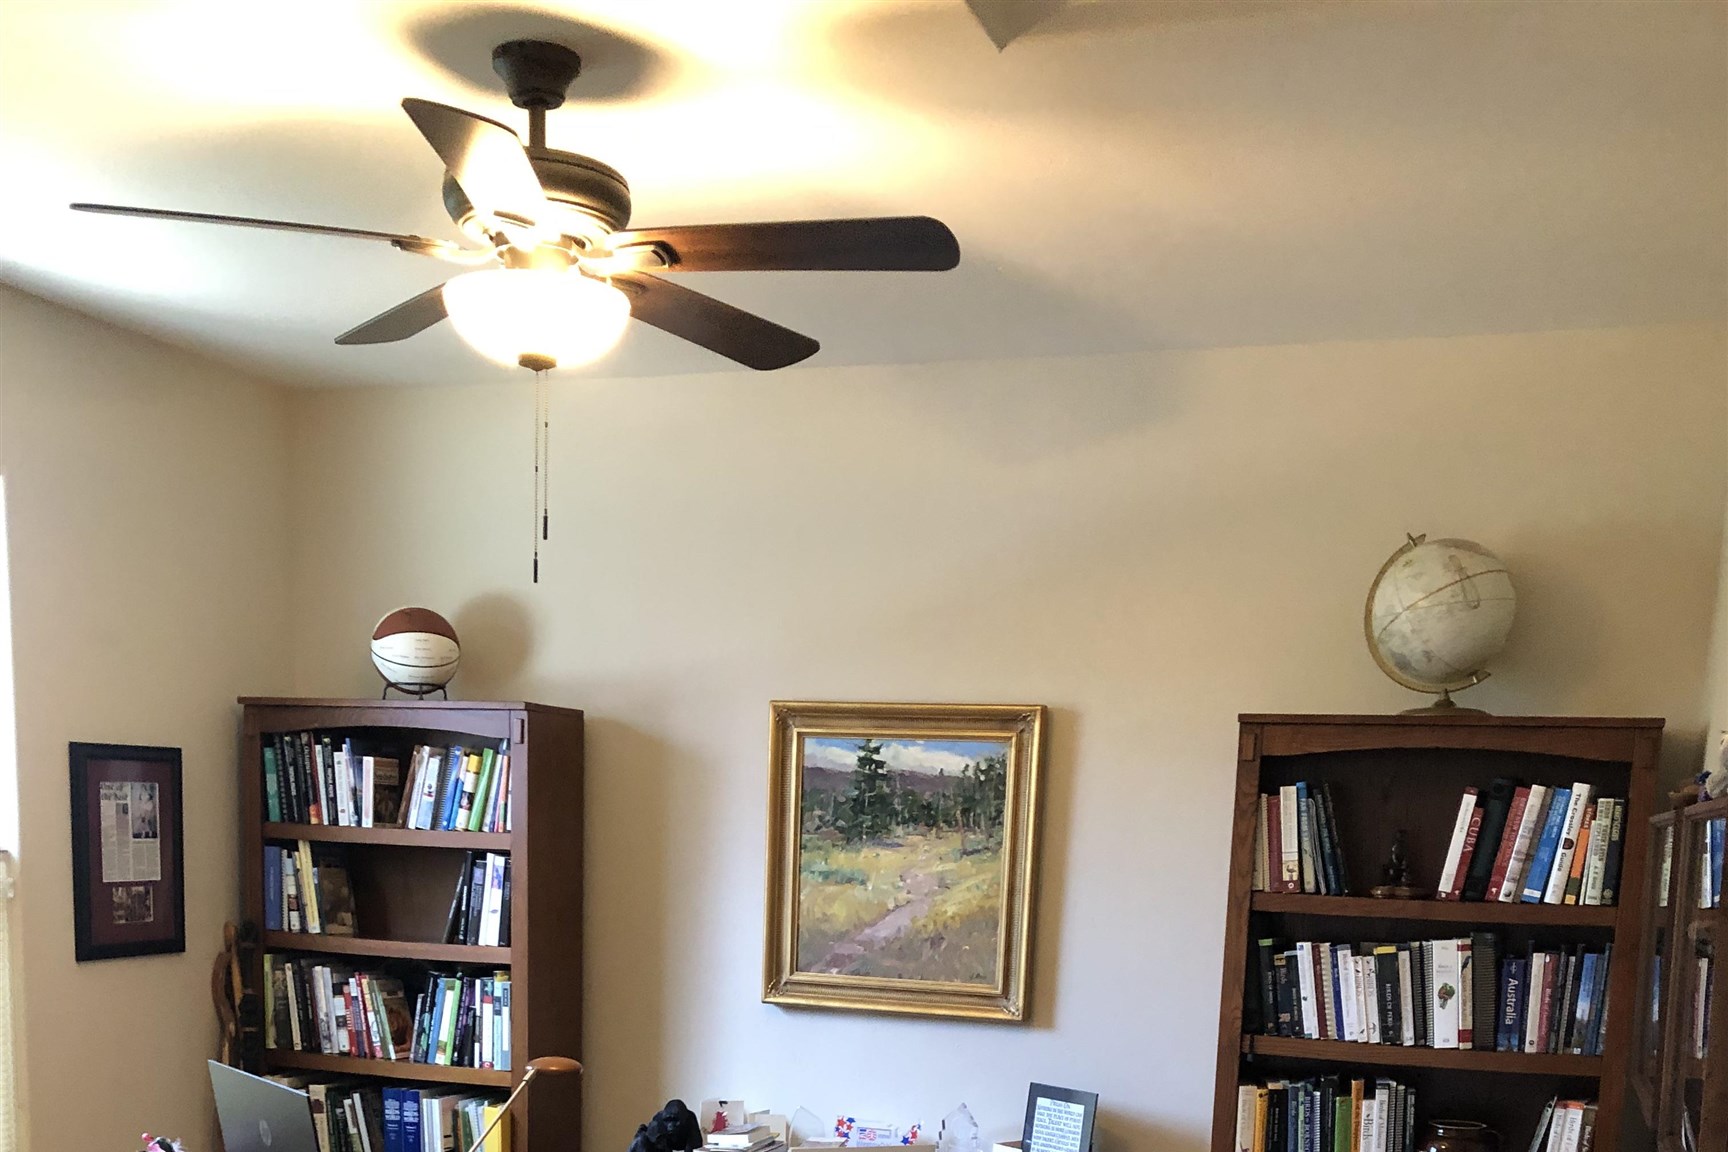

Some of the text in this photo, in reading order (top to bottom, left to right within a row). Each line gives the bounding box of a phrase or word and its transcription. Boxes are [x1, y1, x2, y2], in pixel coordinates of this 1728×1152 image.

[1462, 817, 1482, 853] CUBA
[1557, 793, 1582, 872] The Crossley Guide
[1505, 978, 1519, 1025] Australia
[1304, 1096, 1312, 1118] BIRDS
[1362, 1119, 1374, 1141] Birds
[1567, 1117, 1577, 1133] Birds
